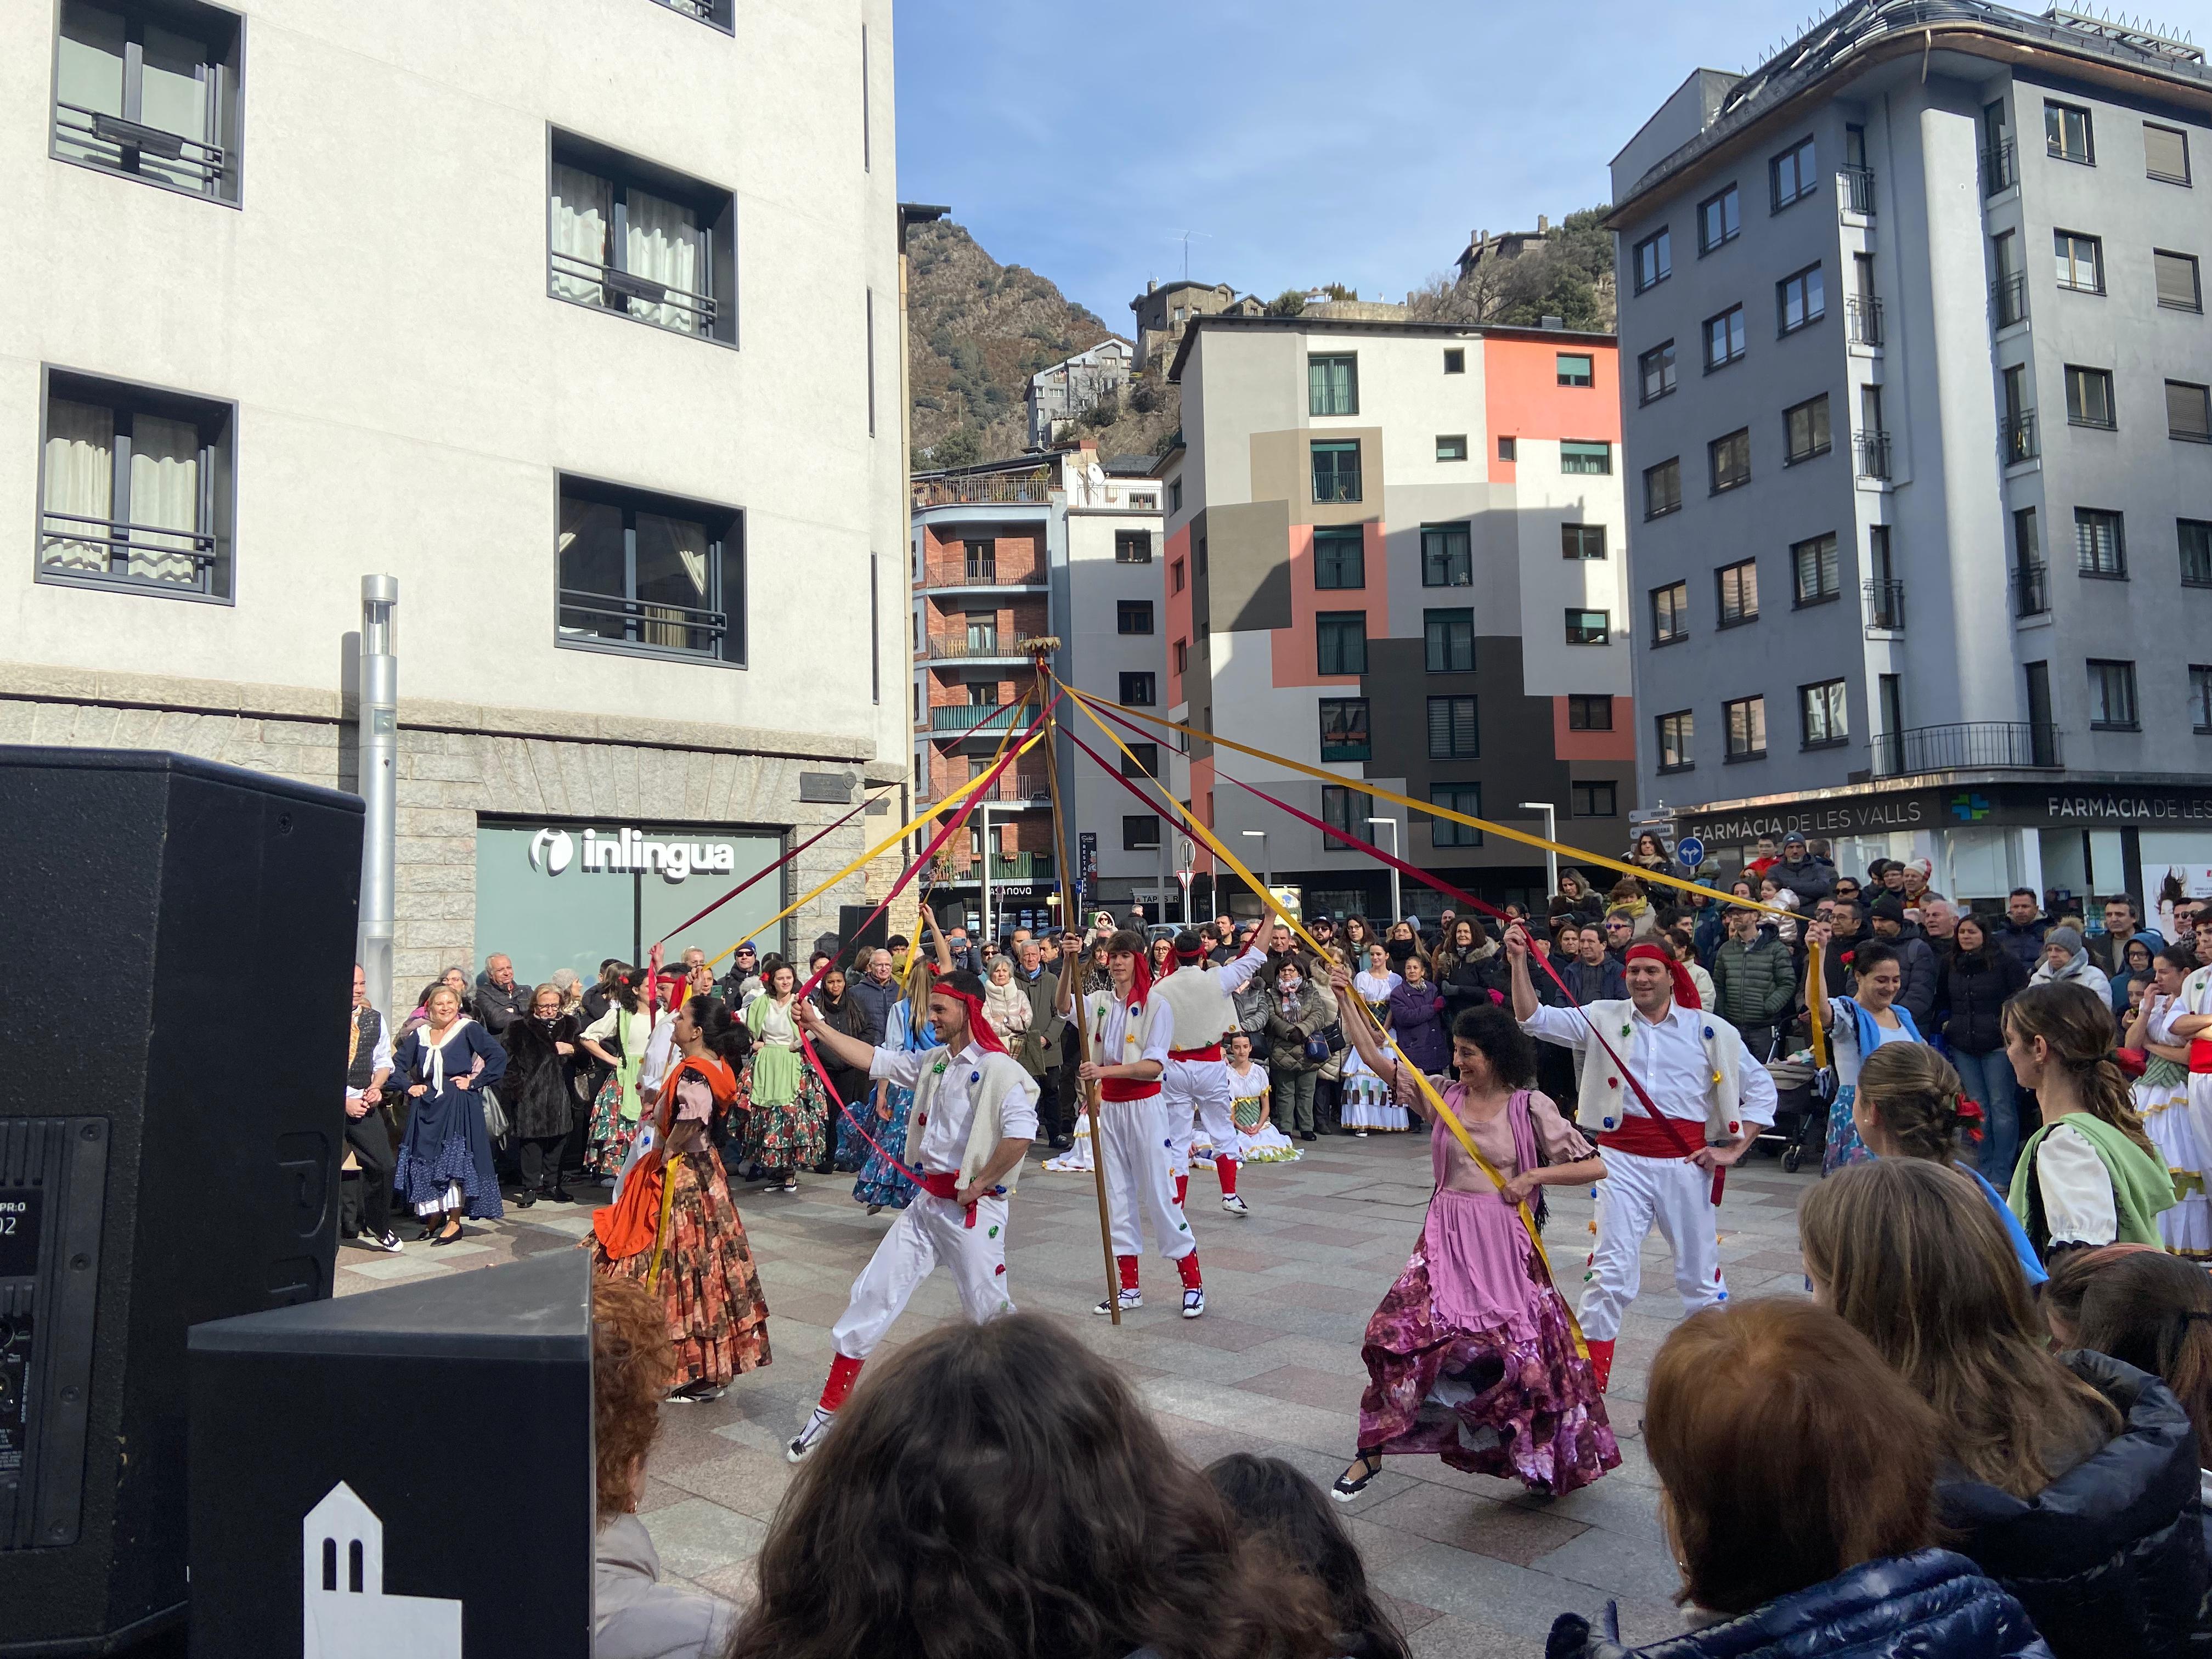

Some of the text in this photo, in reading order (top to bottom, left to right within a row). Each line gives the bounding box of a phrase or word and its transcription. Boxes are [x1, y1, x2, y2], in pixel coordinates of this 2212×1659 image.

[1692, 802, 1921, 841] FARMÀCIA DE LES VALLS
[2047, 793, 2212, 819] FARMÀCIA DE LES
[583, 827, 735, 878] inlingua
[990, 887, 1031, 895] AAnova
